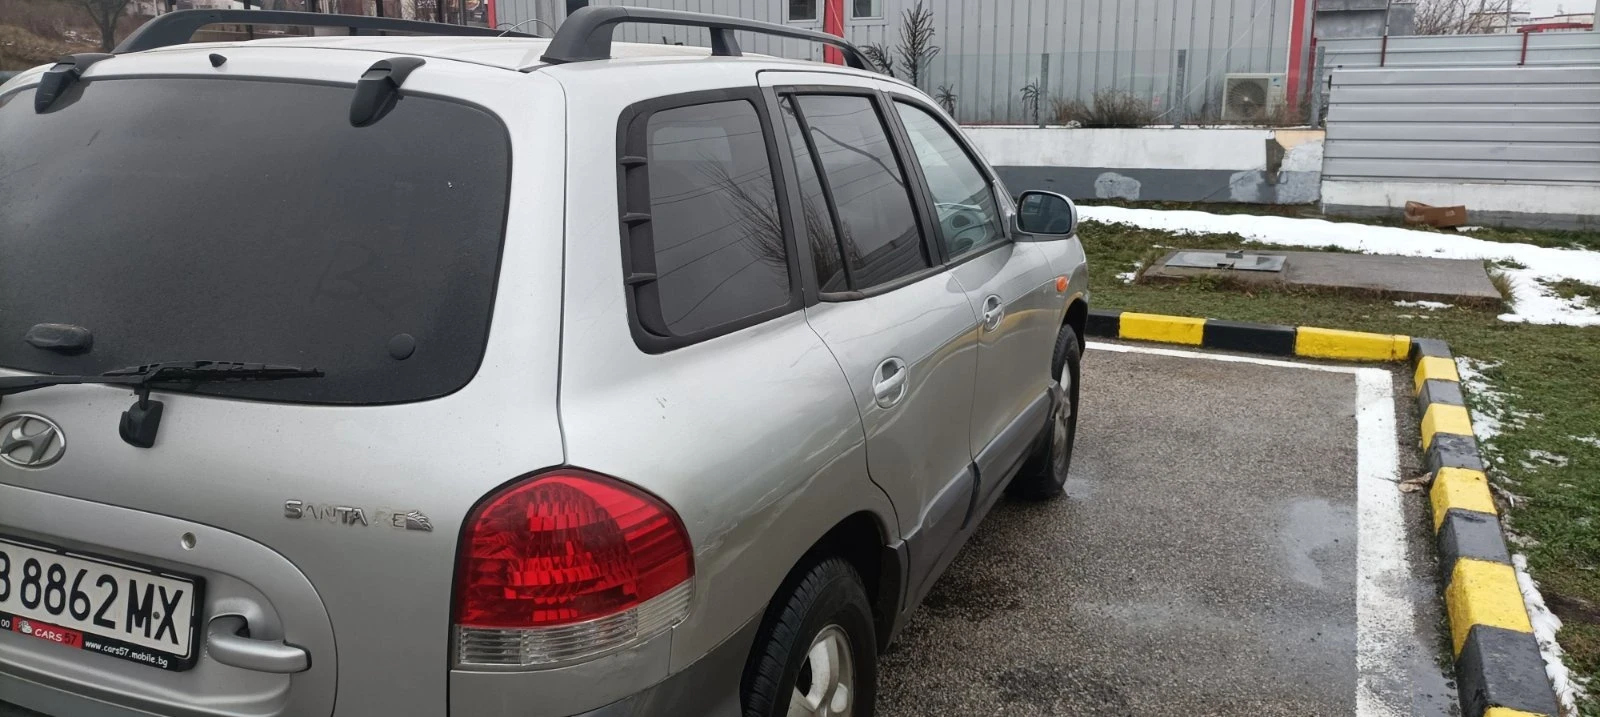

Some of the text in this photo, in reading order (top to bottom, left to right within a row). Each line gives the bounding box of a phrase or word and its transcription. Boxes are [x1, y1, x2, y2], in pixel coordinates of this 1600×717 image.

[284, 499, 368, 527] SANTA
[20, 557, 119, 630] 8862
[34, 628, 62, 642] CARS
[63, 632, 78, 645] 57
[85, 640, 169, 669] www.cars57.mobile.bg
